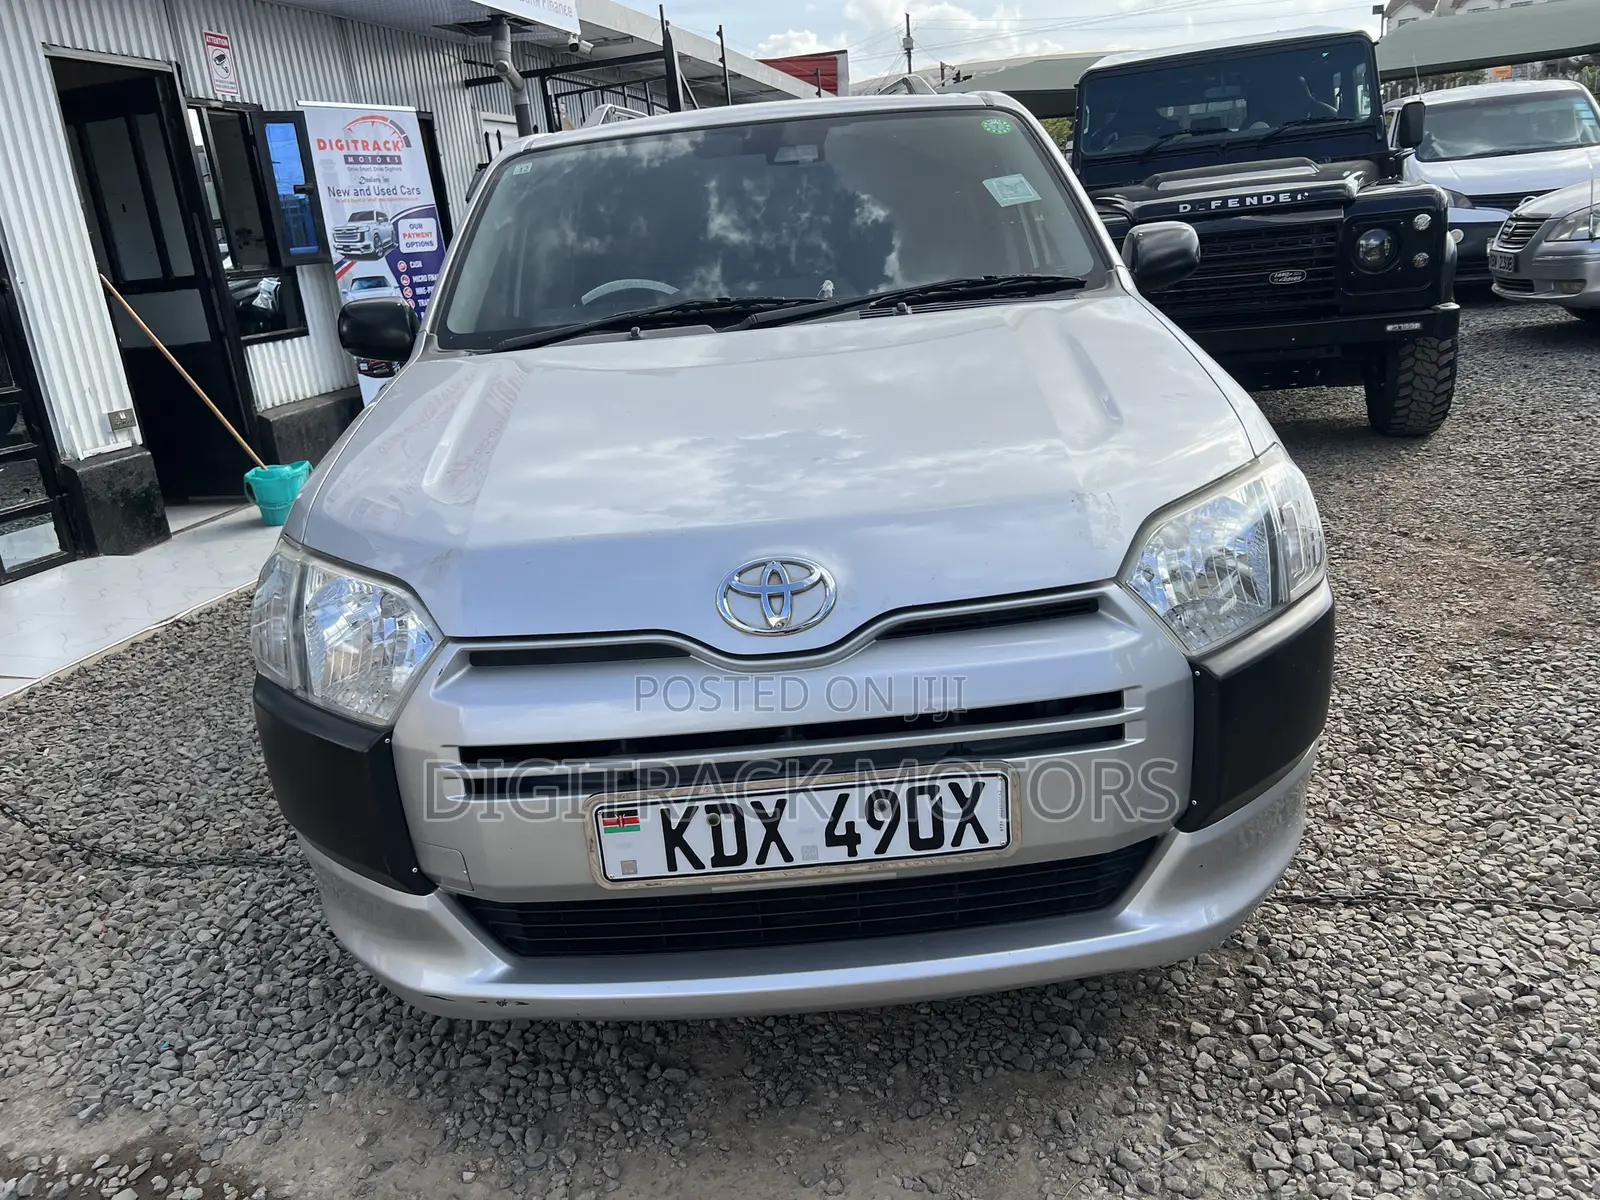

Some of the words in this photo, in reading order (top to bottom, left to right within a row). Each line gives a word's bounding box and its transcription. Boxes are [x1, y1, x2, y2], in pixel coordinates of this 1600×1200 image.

[542, 0, 573, 18] Finance
[316, 138, 401, 152] DIGITRACK
[328, 186, 350, 197] New
[353, 186, 370, 196] and
[373, 185, 397, 196] Used
[400, 185, 421, 195] Cars
[402, 231, 433, 240] PAYMENT
[405, 240, 434, 248] OPTIONS
[412, 274, 427, 283] MICRO
[418, 299, 429, 307] TRA
[660, 798, 794, 872] KDX
[824, 781, 989, 858] 490X
